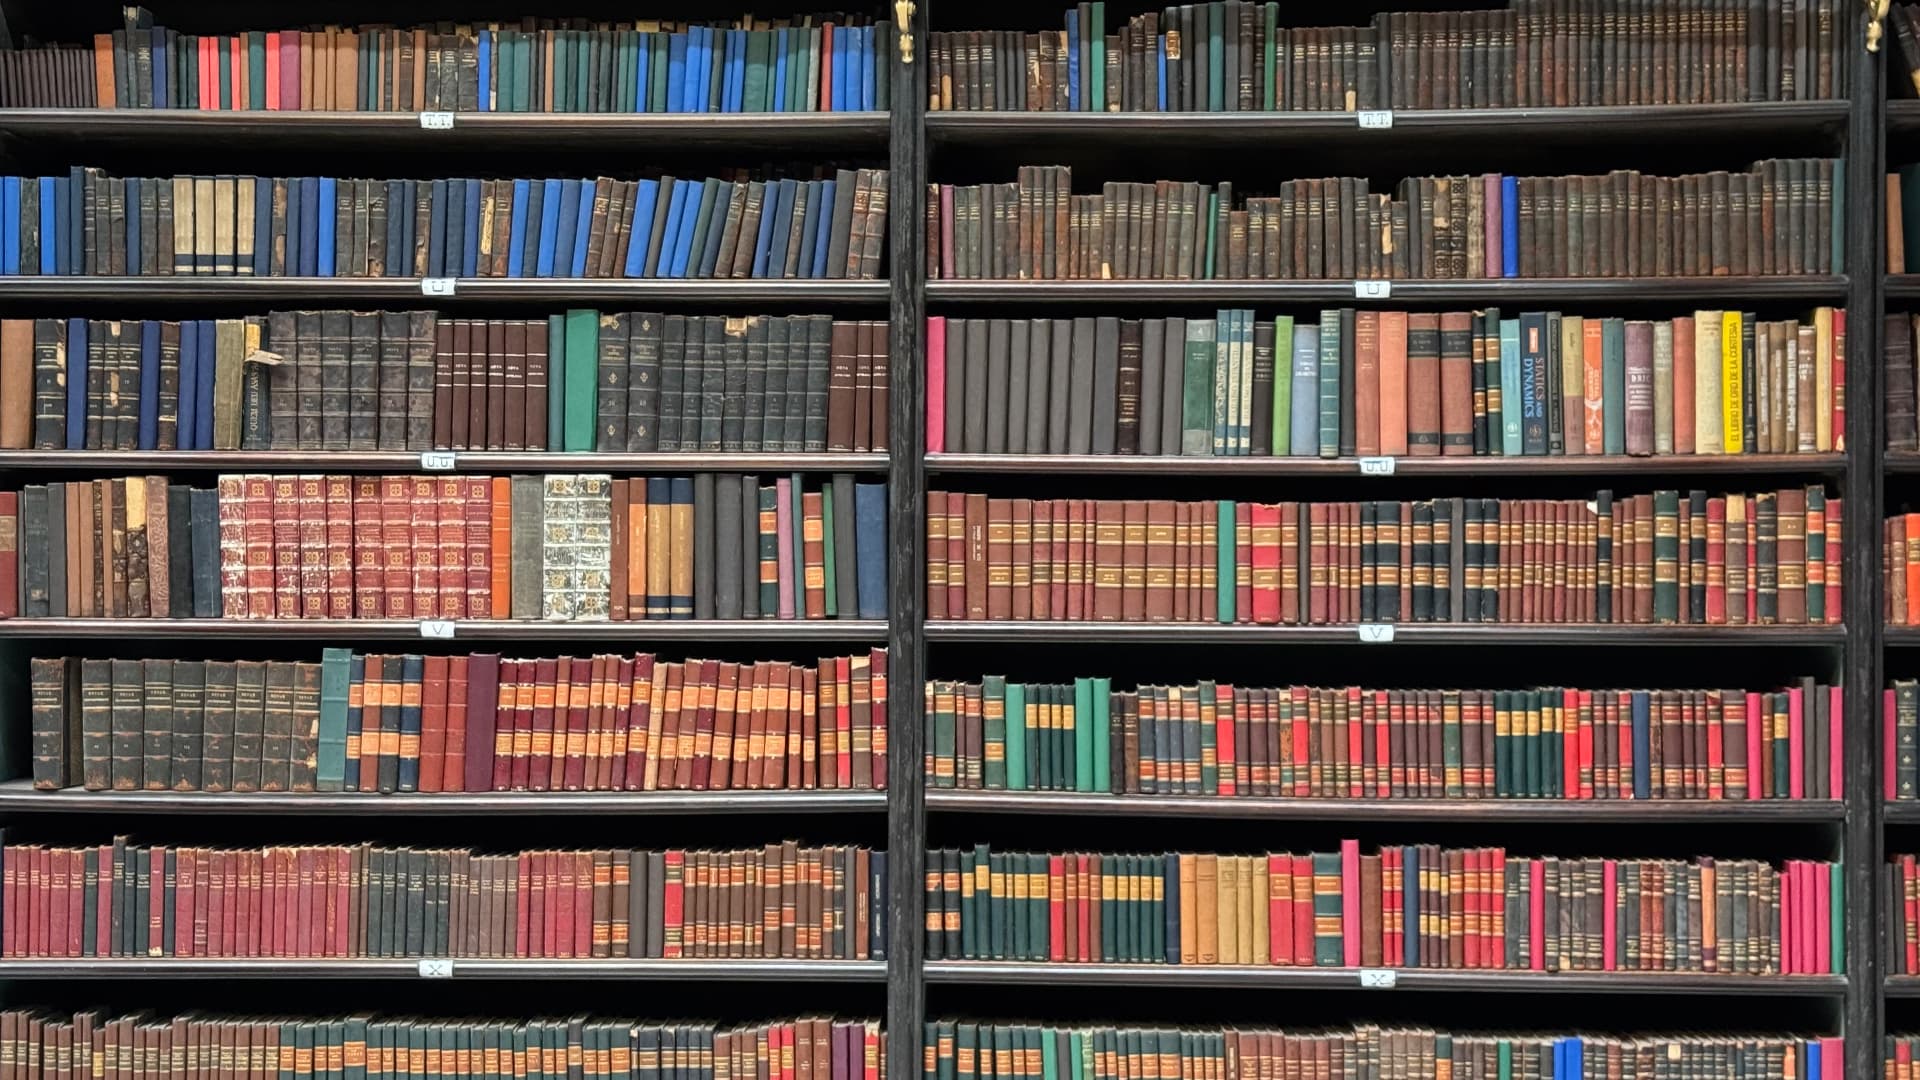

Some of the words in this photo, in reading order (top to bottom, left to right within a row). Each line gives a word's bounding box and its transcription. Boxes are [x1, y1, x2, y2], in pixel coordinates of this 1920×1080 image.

[1366, 283, 1381, 295] U
[1535, 357, 1545, 400] STATICS
[1523, 358, 1535, 418] DYNAMICS
[250, 409, 258, 431] QUEM
[432, 623, 445, 635] V
[1370, 626, 1384, 639] V
[429, 963, 443, 975] X
[1371, 973, 1386, 986] X
